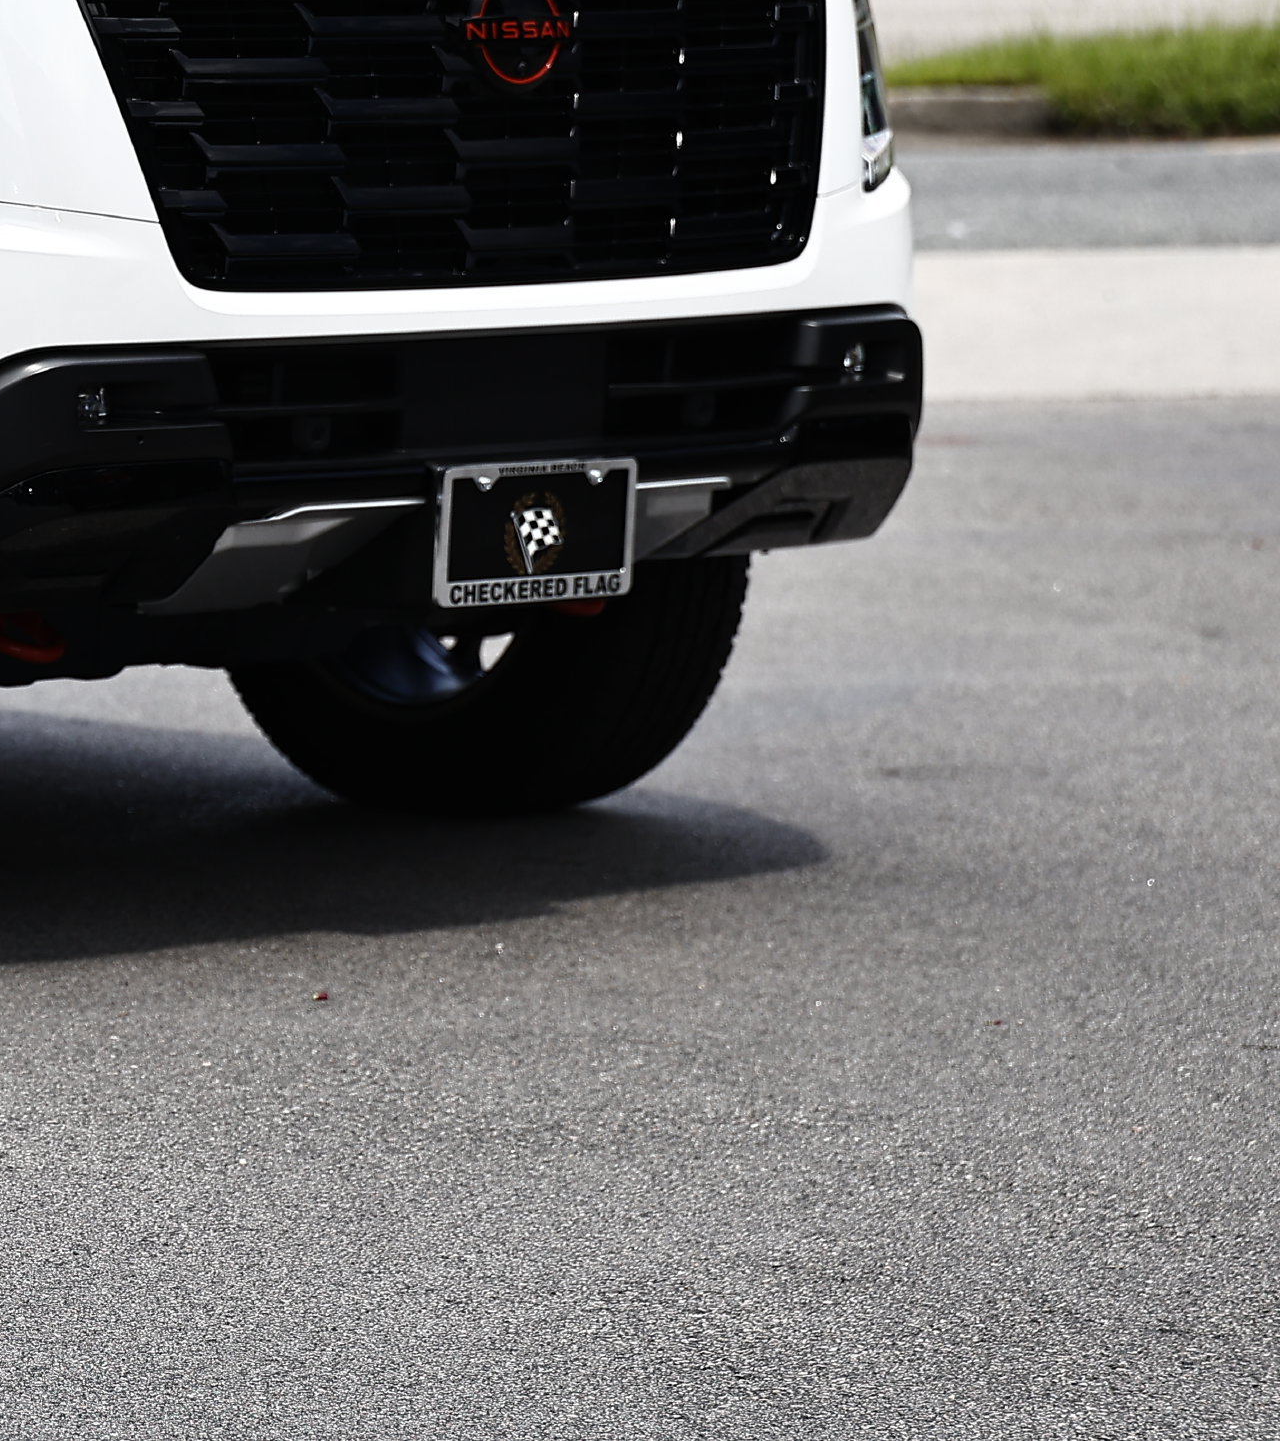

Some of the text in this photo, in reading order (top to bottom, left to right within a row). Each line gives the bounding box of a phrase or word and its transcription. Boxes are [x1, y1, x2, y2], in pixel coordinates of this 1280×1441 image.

[465, 19, 572, 41] NISSAN
[449, 573, 621, 605] CHECKERED FLAG
